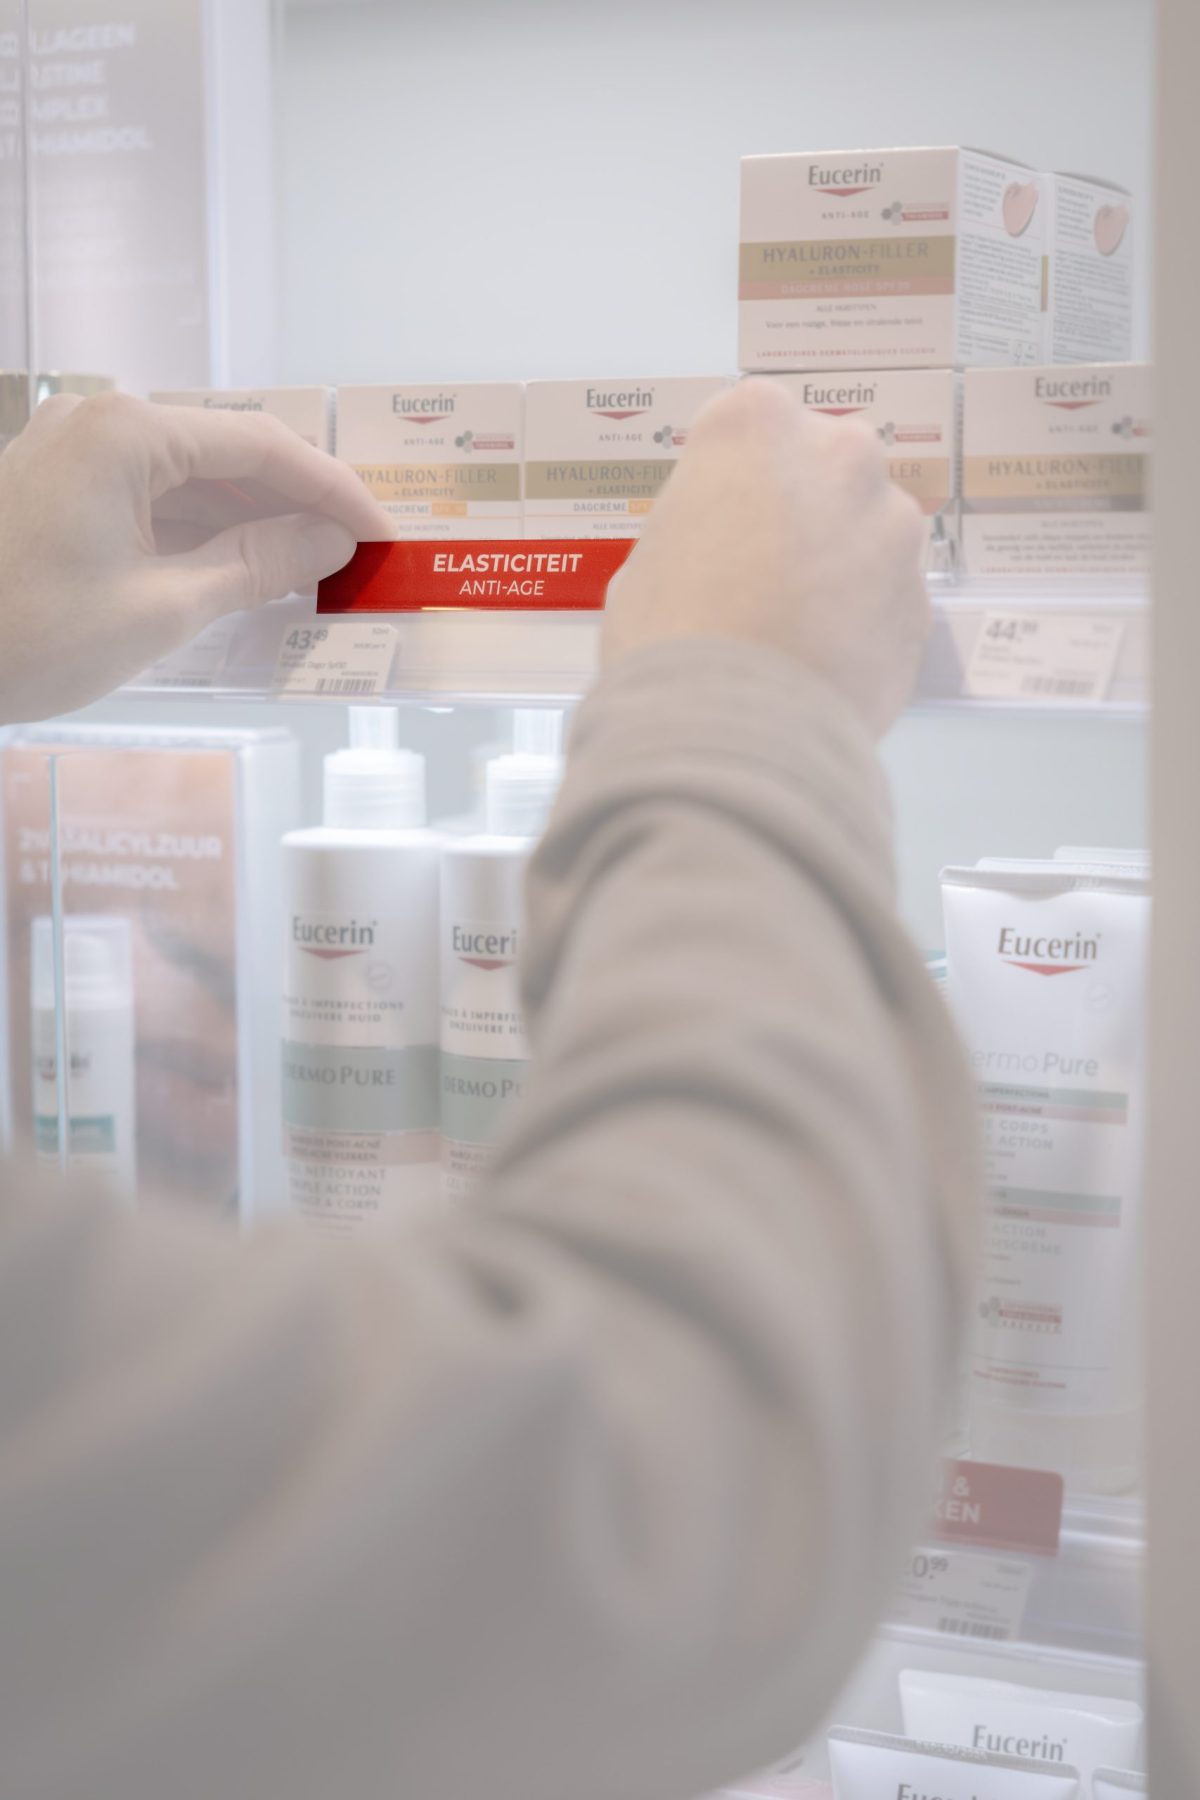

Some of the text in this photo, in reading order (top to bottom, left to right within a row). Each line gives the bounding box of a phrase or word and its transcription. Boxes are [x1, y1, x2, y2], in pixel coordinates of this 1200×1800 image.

[808, 163, 881, 186] Eucerin
[821, 211, 870, 221] ANTI-AGE
[763, 242, 929, 263] HYALURON-FILLER
[818, 264, 880, 275] ELASTICITY
[803, 383, 874, 404] Eucerin
[1034, 375, 1111, 398] Eucerin
[392, 393, 455, 413] Eucerin
[586, 387, 652, 408] Eucerin
[404, 438, 445, 446] ANTI-AGE
[599, 433, 642, 442] ANTI-AGE
[402, 487, 455, 497] ELASTICITY
[433, 554, 582, 572] ELASTICITEIT
[459, 580, 544, 595] ANTI-AGE
[286, 628, 328, 649] 43.49
[293, 916, 374, 945] Eucerin
[453, 926, 517, 954] Euceri
[997, 927, 1097, 960] Eucerin
[971, 1050, 1099, 1077] ermoPure
[906, 1555, 948, 1579] 0.99
[973, 1724, 1063, 1762] Eucerin
